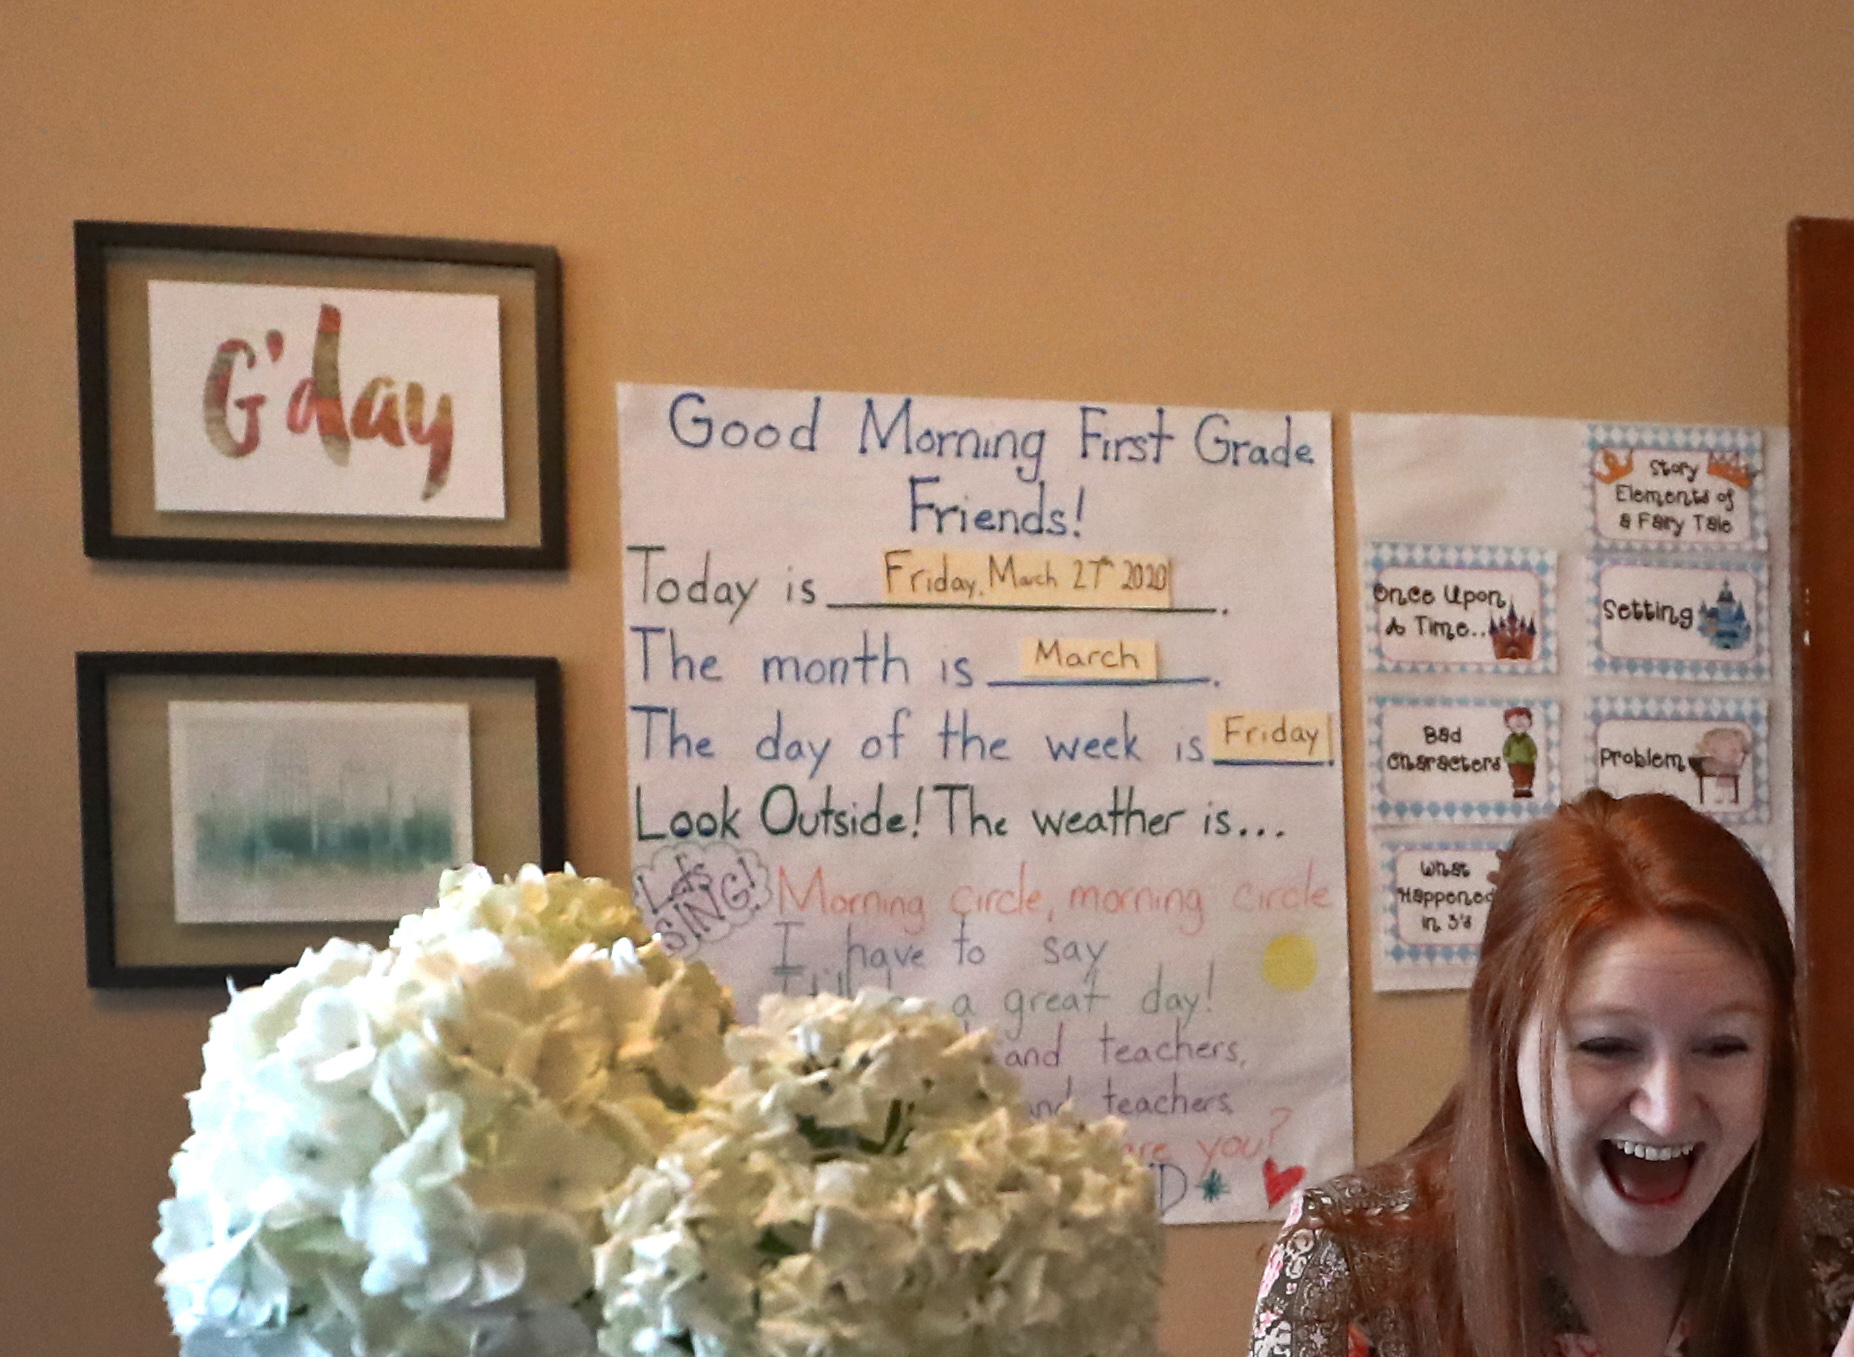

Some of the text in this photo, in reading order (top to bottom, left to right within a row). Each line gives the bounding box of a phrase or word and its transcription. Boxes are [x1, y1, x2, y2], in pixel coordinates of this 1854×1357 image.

[203, 303, 454, 501] G'day
[668, 391, 1316, 483] Good Morning First Grade
[1615, 484, 1735, 512] Elements of
[1649, 458, 1699, 483] Story
[908, 474, 1085, 538] Friends!
[1638, 511, 1685, 537] Fairy
[1692, 513, 1733, 534] Tale
[626, 545, 759, 625] Today
[785, 564, 817, 605] is
[987, 554, 1058, 590] March
[1120, 559, 1168, 591] 2020
[1373, 583, 1508, 611] Once Upon
[1385, 616, 1406, 636] A
[1602, 598, 1694, 630] Setting
[629, 625, 1139, 689] The month is March
[629, 705, 1320, 780] The day of the week is Friday
[1423, 724, 1463, 744] Bad
[1600, 747, 1686, 773] Problem
[1387, 751, 1501, 773] Characters
[635, 782, 1287, 841] Look Outside! The weather is...
[1420, 860, 1472, 878] What
[778, 860, 1334, 937] Morning circle, morning circle
[773, 912, 1109, 983] I have to say
[951, 993, 976, 1018] a
[1002, 980, 1112, 1043] great
[1140, 959, 1216, 1030] day!
[1004, 1017, 1249, 1069] and teachers,
[1198, 1106, 1295, 1181] you?
